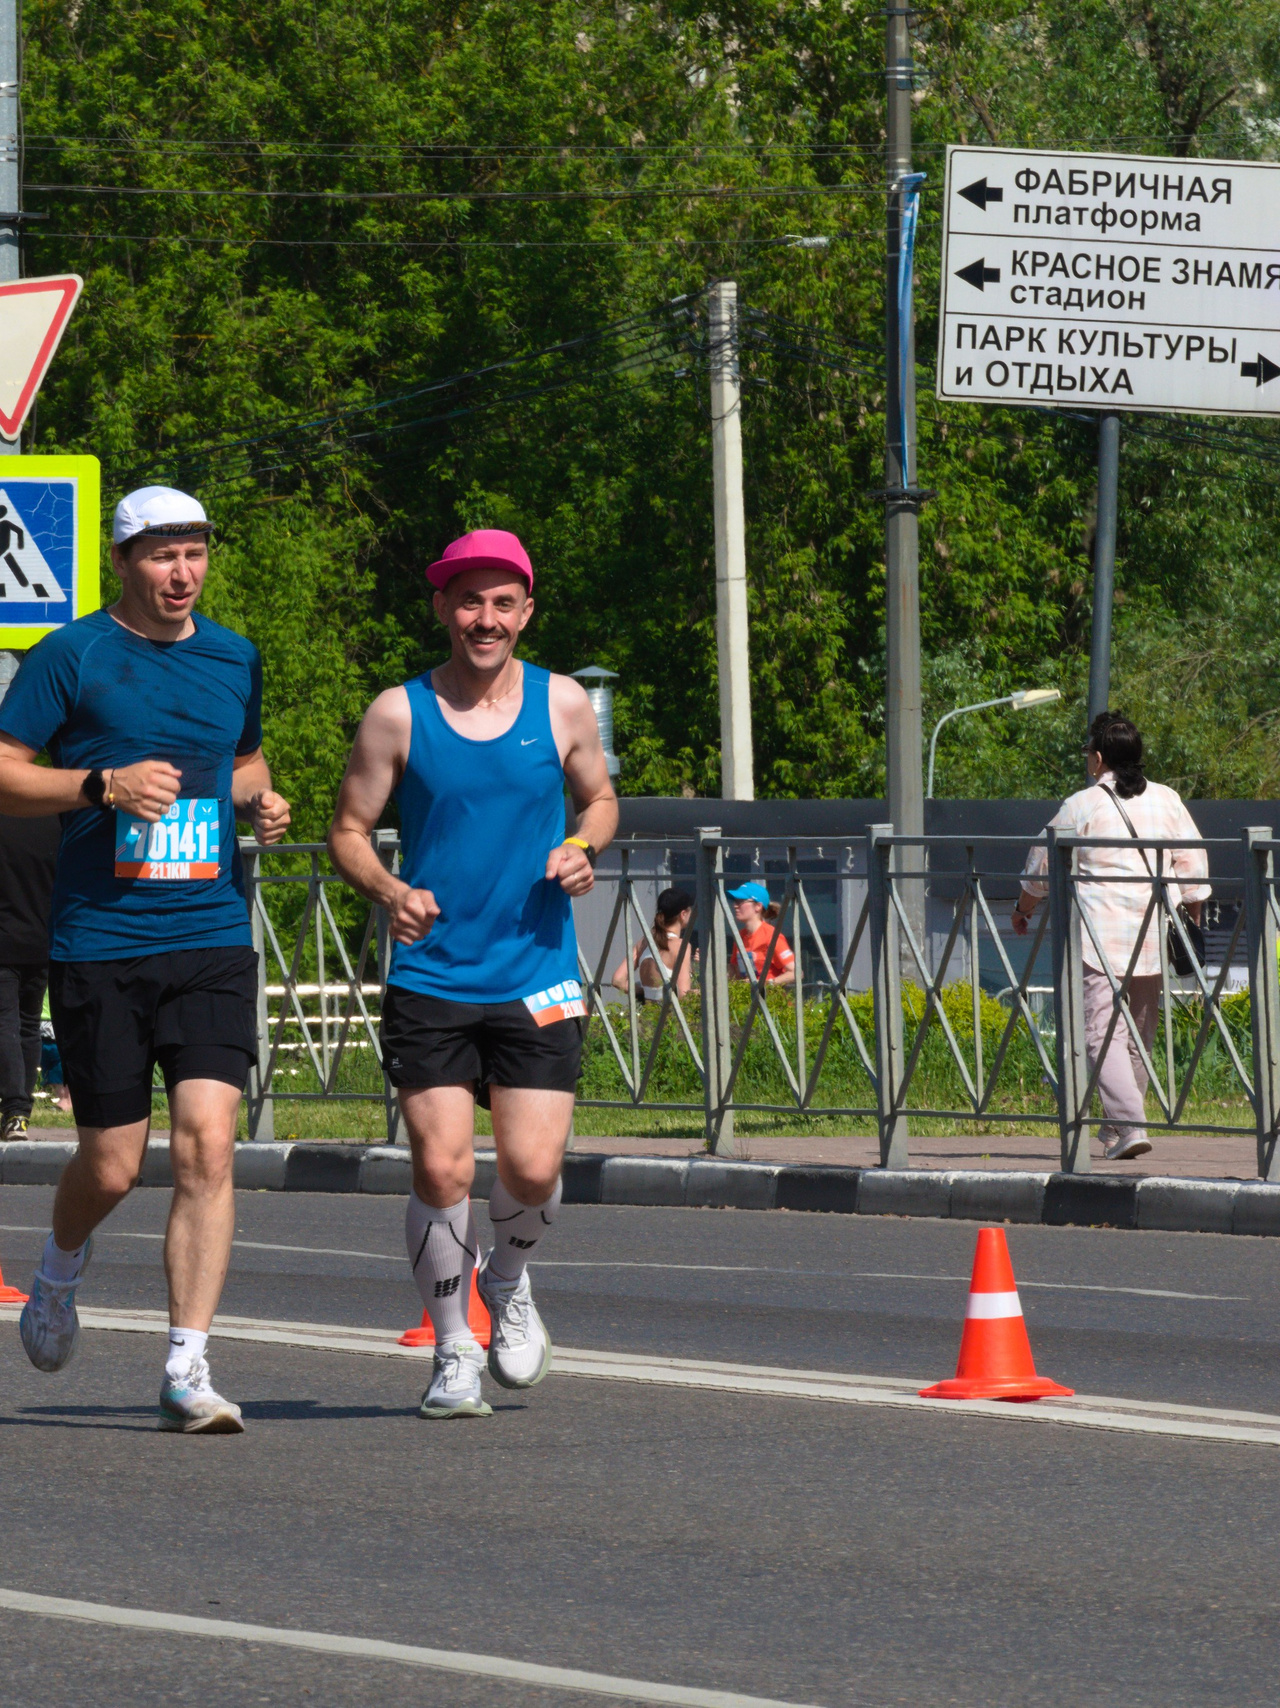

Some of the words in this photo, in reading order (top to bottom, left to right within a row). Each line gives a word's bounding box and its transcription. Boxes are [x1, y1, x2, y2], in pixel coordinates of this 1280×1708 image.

[1014, 167, 1232, 205] ФАБРИЧНАЯ
[1013, 201, 1201, 236] платформа
[1011, 249, 1161, 284] КРАСНОЕ
[1171, 257, 1280, 290] ЗНАМЯ
[1010, 284, 1145, 312] стадион
[956, 323, 1047, 353] ПАРК
[1058, 328, 1237, 364] КУЛЬТУРЫ
[955, 366, 973, 386] и
[985, 360, 1134, 396] ОТДЫХА
[131, 821, 208, 860] 70141
[149, 862, 190, 879] 21.1KM
